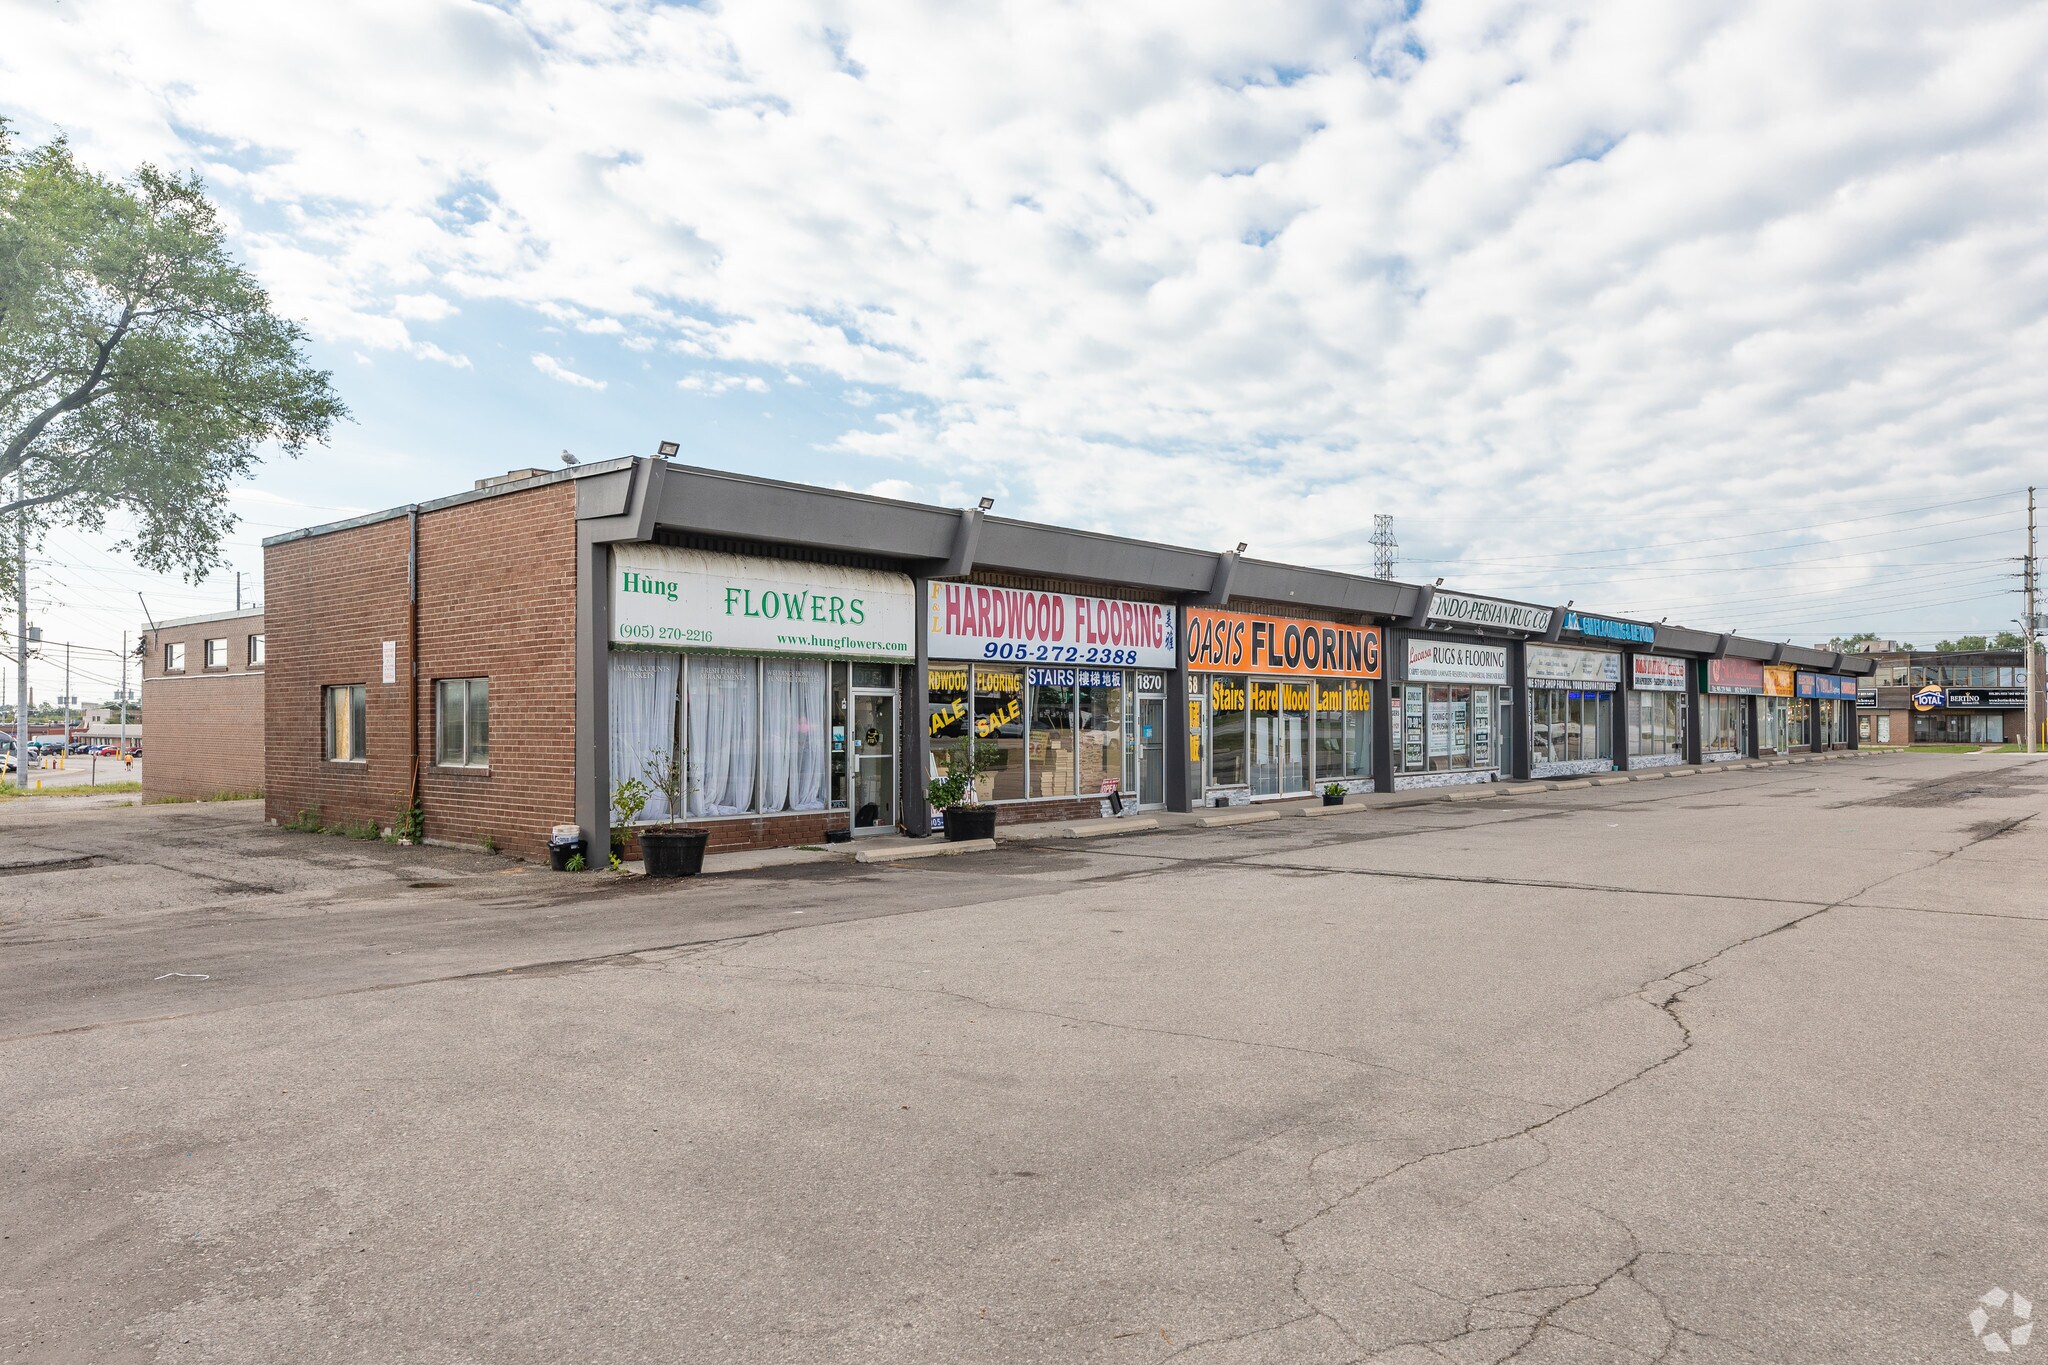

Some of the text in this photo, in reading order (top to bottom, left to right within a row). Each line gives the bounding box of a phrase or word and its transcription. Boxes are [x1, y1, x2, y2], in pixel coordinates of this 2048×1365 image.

[622, 572, 678, 602] Hùng
[931, 582, 942, 599] F
[724, 587, 866, 626] FLOWERS
[945, 584, 1064, 642] HARDWOOD
[1075, 597, 1163, 649] FLOORING
[1435, 596, 1548, 629] INDO-PERSIAN RUG CO.
[619, 624, 713, 643] (905) 270-2216
[931, 615, 942, 633] L
[776, 633, 908, 653] www.hungflowers.com
[983, 641, 1138, 665] 905-272-2388
[1188, 616, 1245, 665] OASIS
[1251, 620, 1379, 673] FLOORING
[1433, 647, 1455, 665] RUGS
[1457, 649, 1463, 665] &
[1465, 650, 1504, 668] FLOORING
[928, 671, 1020, 693] RDWOOD FLOORING
[1028, 669, 1074, 686] STAIRS
[1137, 675, 1162, 691] 1870
[1188, 675, 1198, 693] 68
[1213, 680, 1244, 711] Stairs
[1250, 682, 1279, 711] Hard
[1283, 684, 1310, 711] Wood
[1918, 696, 1942, 705] TOTAL
[977, 699, 1021, 738] SALE
[931, 818, 944, 827] 05-
